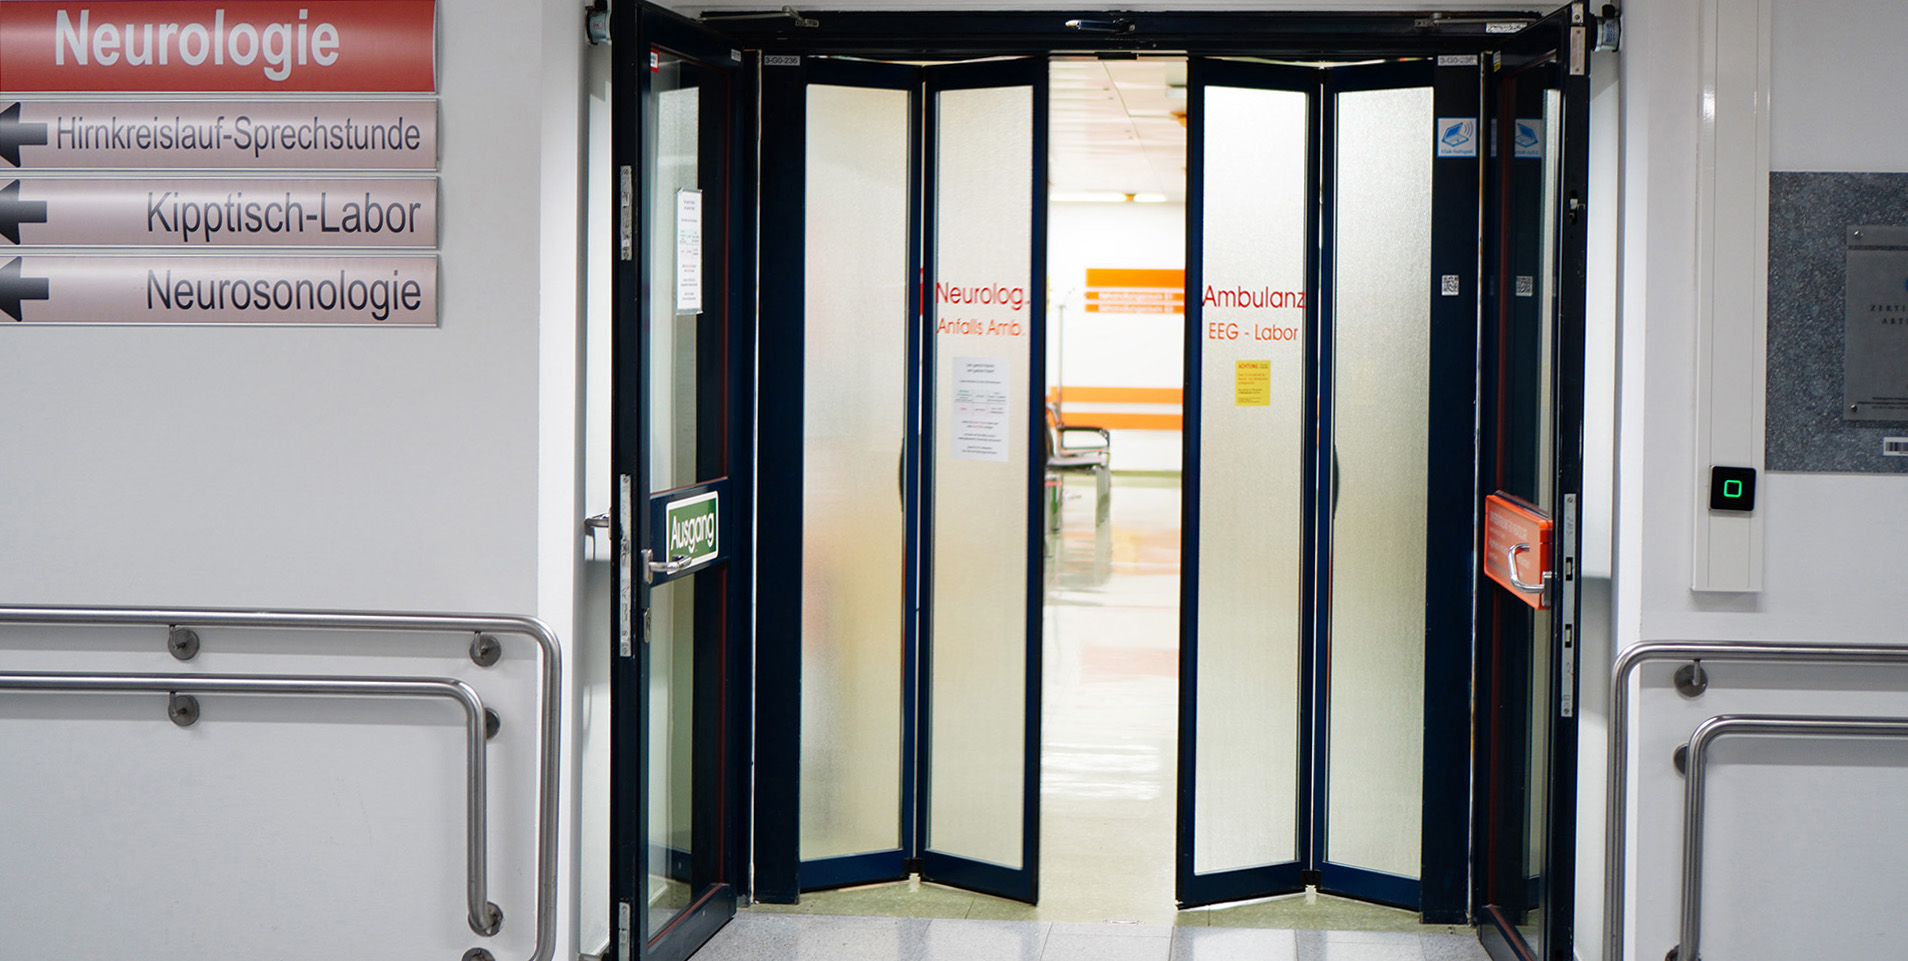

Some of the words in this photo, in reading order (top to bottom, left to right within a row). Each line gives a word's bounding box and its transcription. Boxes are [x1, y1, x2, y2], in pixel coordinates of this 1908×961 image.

[54, 9, 340, 81] Neurologie
[56, 116, 421, 158] Hirnkreislauf-Sprechstunde
[147, 191, 421, 243] Kipptisch-Labor
[147, 269, 421, 322] Neurosonologie
[936, 282, 1030, 311] Neurolog.
[1202, 285, 1306, 308] Ambulanz
[1870, 304, 1908, 312] ZERTI
[936, 318, 983, 335] Anfalls
[986, 319, 1026, 336] Amb.
[1208, 322, 1239, 340] EEG
[1254, 323, 1298, 341] Labor
[670, 512, 714, 554] Ausgang
